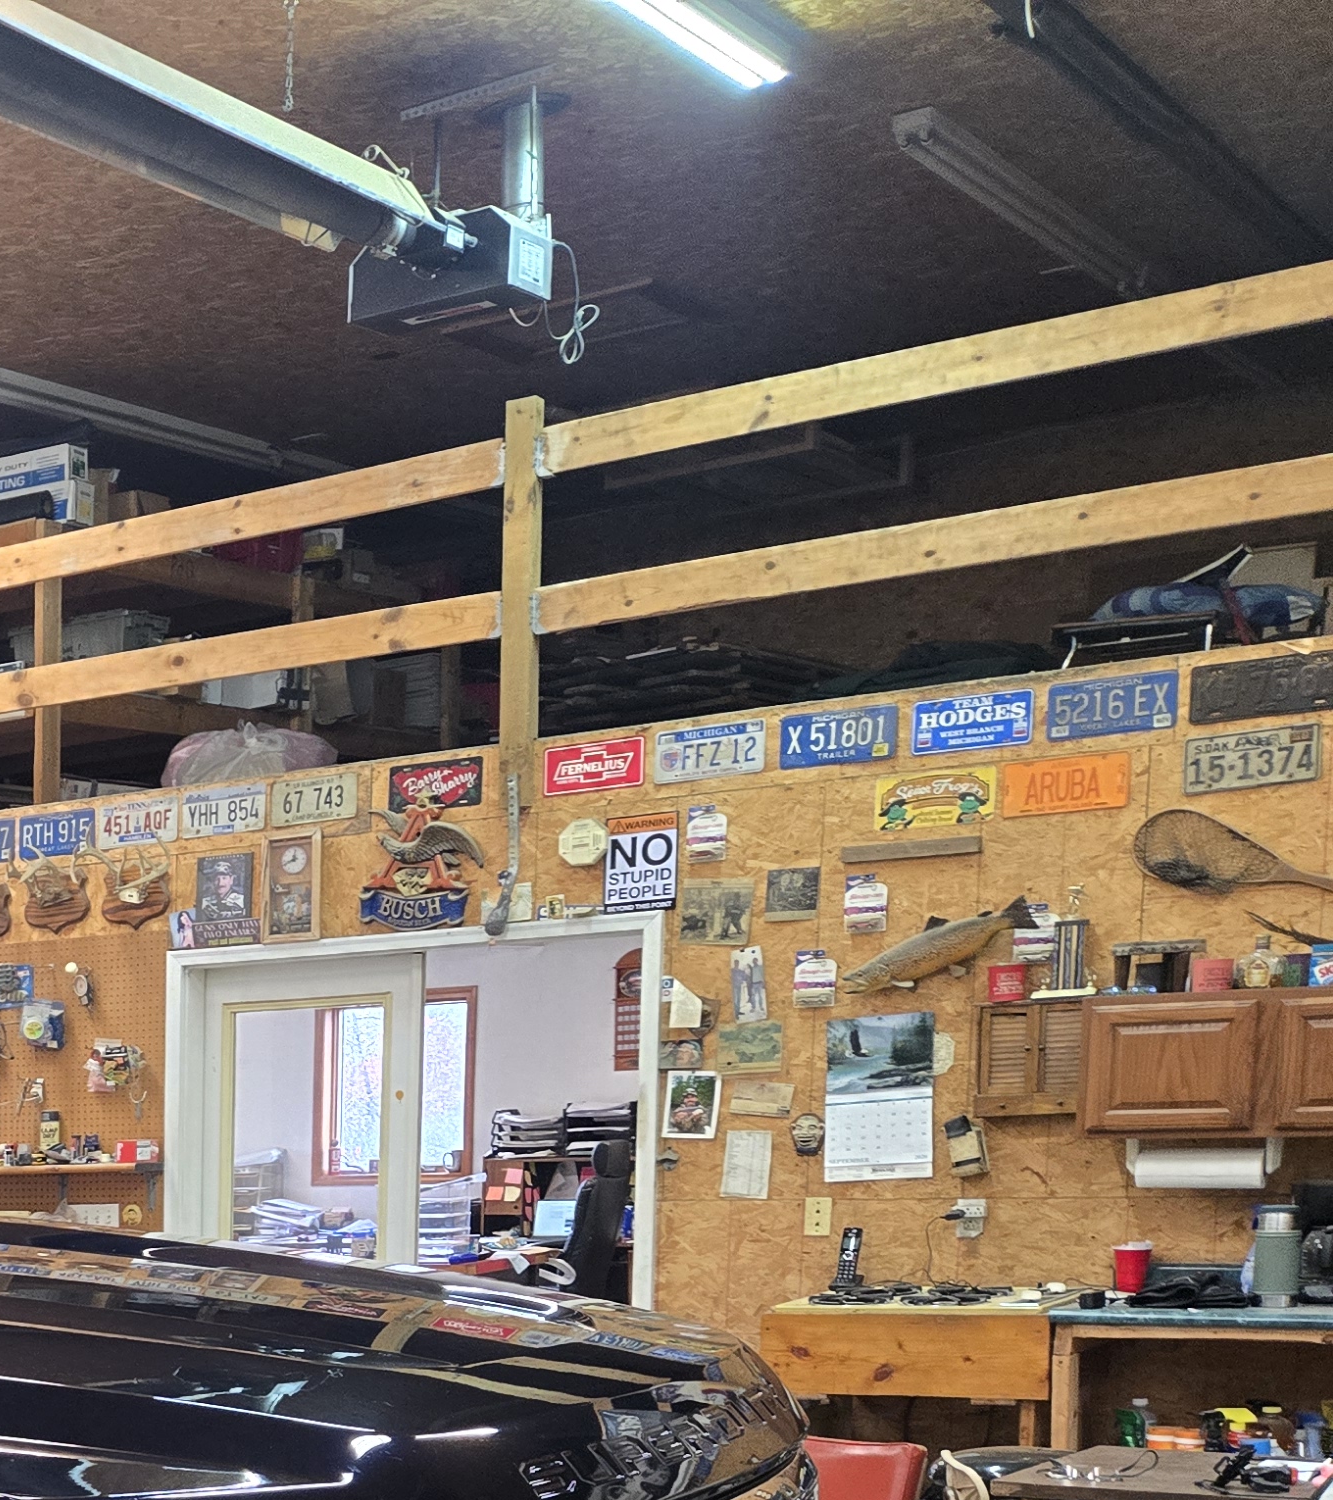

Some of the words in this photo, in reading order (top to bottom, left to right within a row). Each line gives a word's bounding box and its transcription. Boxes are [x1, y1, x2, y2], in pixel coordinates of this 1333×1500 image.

[4, 461, 28, 472] DUTY
[1084, 678, 1142, 691] MICHIGAN
[952, 696, 994, 709] TEAM
[1055, 689, 1124, 725] 5216
[1135, 682, 1169, 716] EX
[812, 710, 864, 722] MICHIGAN
[919, 701, 1026, 730] HODGES
[1113, 719, 1140, 729] LAKES
[683, 726, 739, 740] MICHIGAN
[787, 725, 802, 755] X
[809, 715, 885, 752] 51801
[939, 728, 964, 739] WEST
[966, 725, 1004, 736] BRANCH
[948, 735, 994, 746] MICHIGAN
[683, 741, 722, 769] FFZ
[732, 736, 757, 764] 12
[817, 749, 856, 760] TRAILER
[560, 759, 625, 776] FERNELIUS
[1189, 744, 1314, 786] 15-1374
[1025, 767, 1100, 804] ARUBA
[283, 790, 303, 815] 67
[313, 784, 344, 811] 743
[38, 814, 74, 822] MICHIGAN
[188, 803, 219, 827] YHH
[227, 797, 259, 822] 854
[103, 814, 132, 836] 451
[143, 808, 172, 832] AQF
[625, 817, 674, 830] WARNING
[23, 822, 54, 848] RTH
[58, 817, 90, 843] 915
[610, 833, 673, 870] NO
[608, 867, 672, 886] STUPID
[608, 883, 672, 901] PEOPLE
[378, 895, 443, 920] BUSCH
[606, 902, 634, 912] BEYOND
[635, 901, 651, 910] THIS
[651, 900, 672, 909] POINT
[203, 930, 222, 938] TWO
[519, 1413, 720, 1500] SUPER
